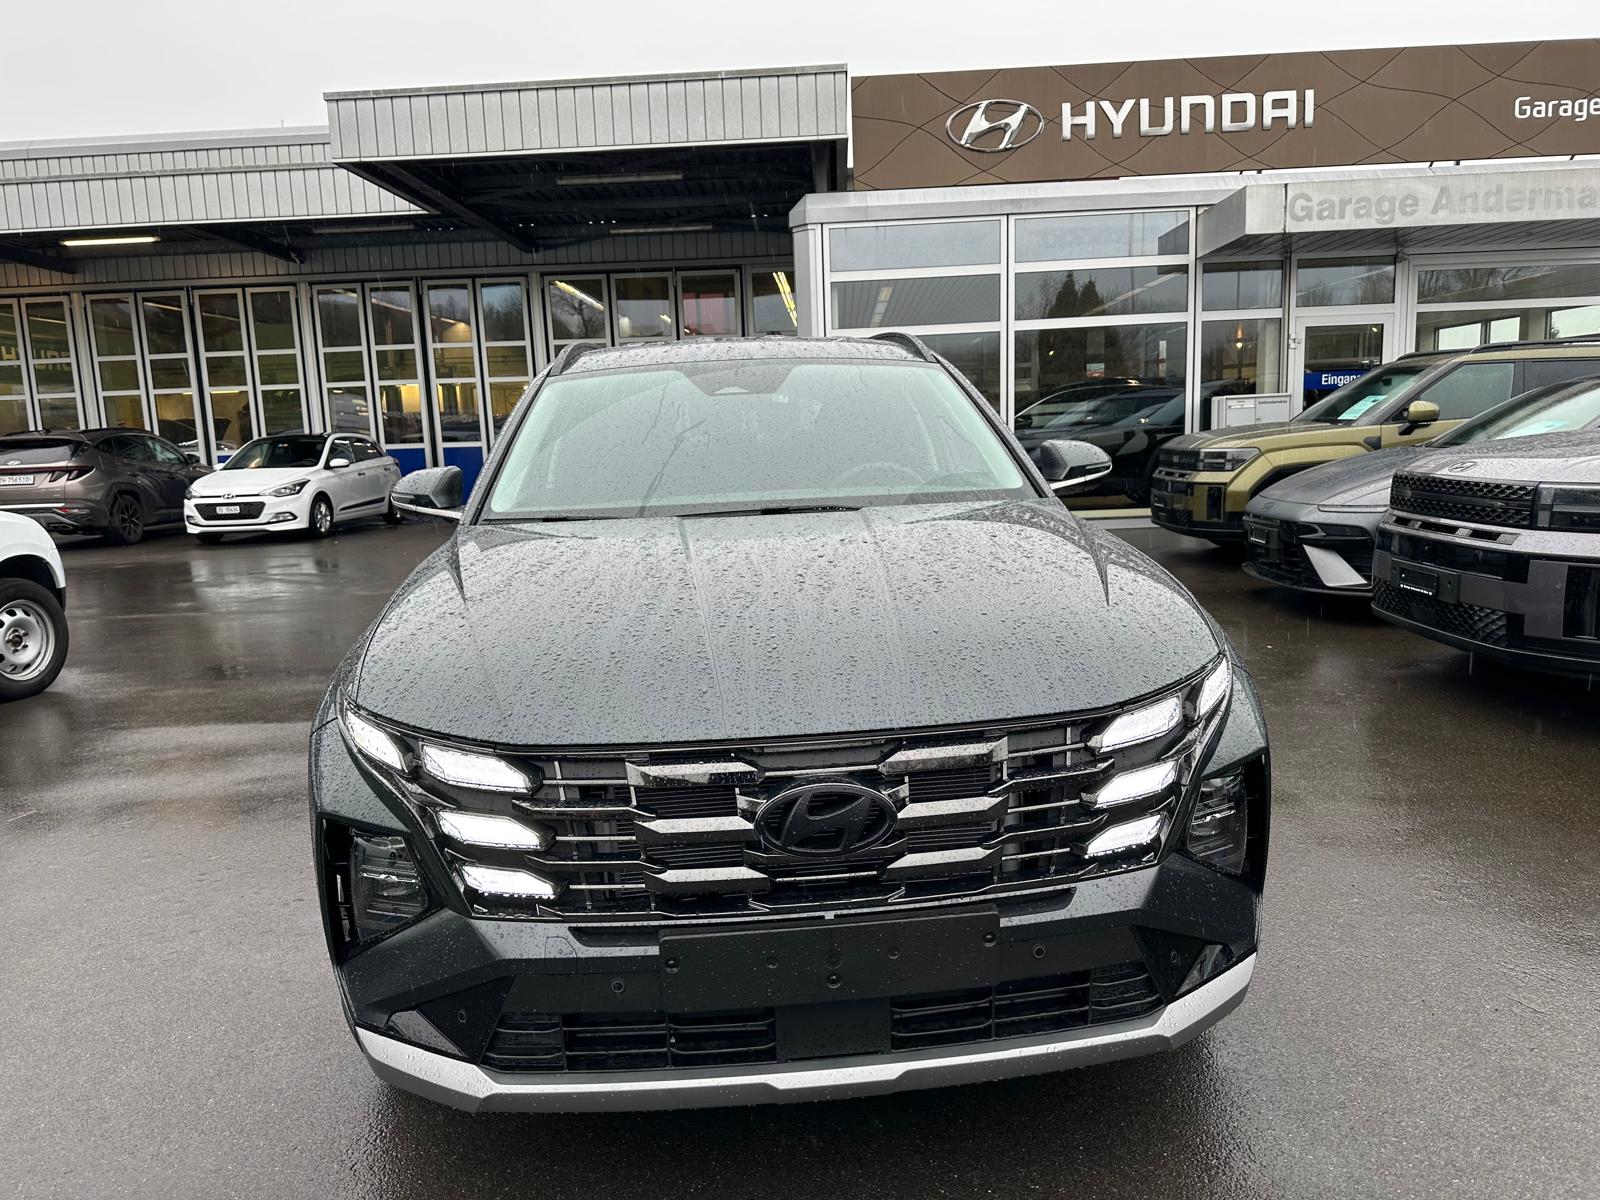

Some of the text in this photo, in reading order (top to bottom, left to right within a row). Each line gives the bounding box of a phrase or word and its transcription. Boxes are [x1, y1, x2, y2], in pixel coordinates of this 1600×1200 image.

[1061, 88, 1315, 141] HYUNDAI
[1514, 96, 1600, 122] Garage
[1288, 192, 1420, 225] Garage
[1321, 373, 1361, 387] Eingan
